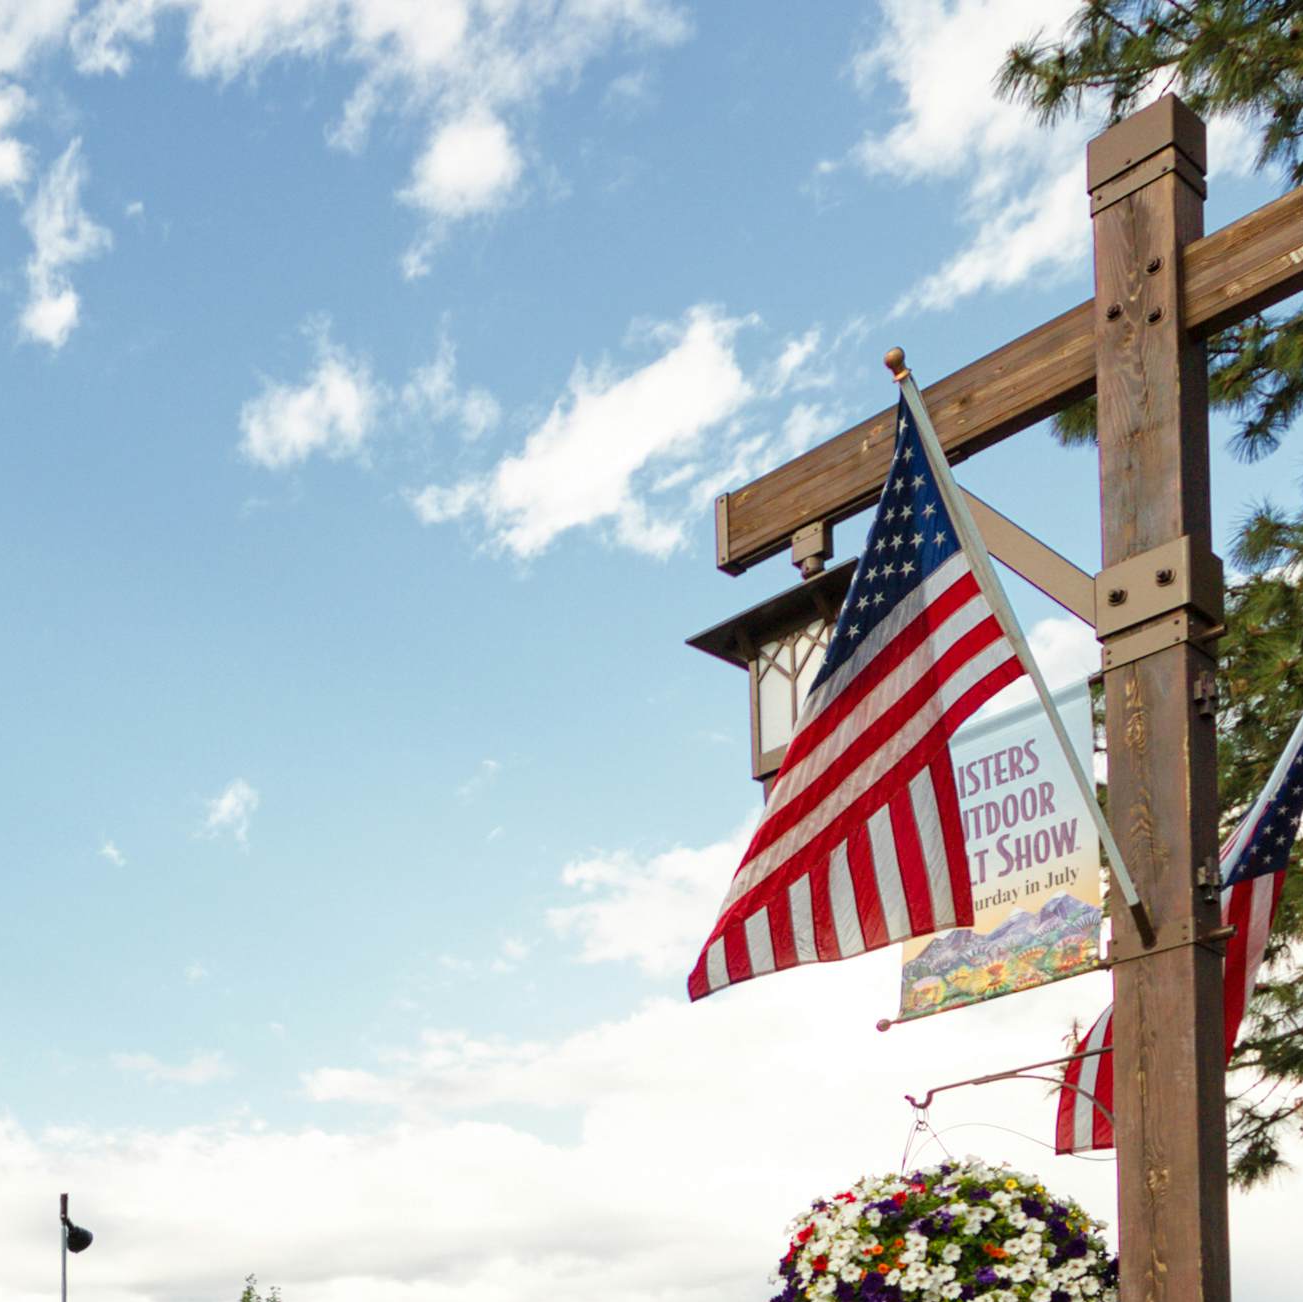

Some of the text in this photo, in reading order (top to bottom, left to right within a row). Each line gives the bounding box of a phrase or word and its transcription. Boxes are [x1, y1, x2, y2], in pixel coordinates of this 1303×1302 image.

[958, 738, 1039, 799] ISTERS
[975, 866, 1080, 911] urday in July
